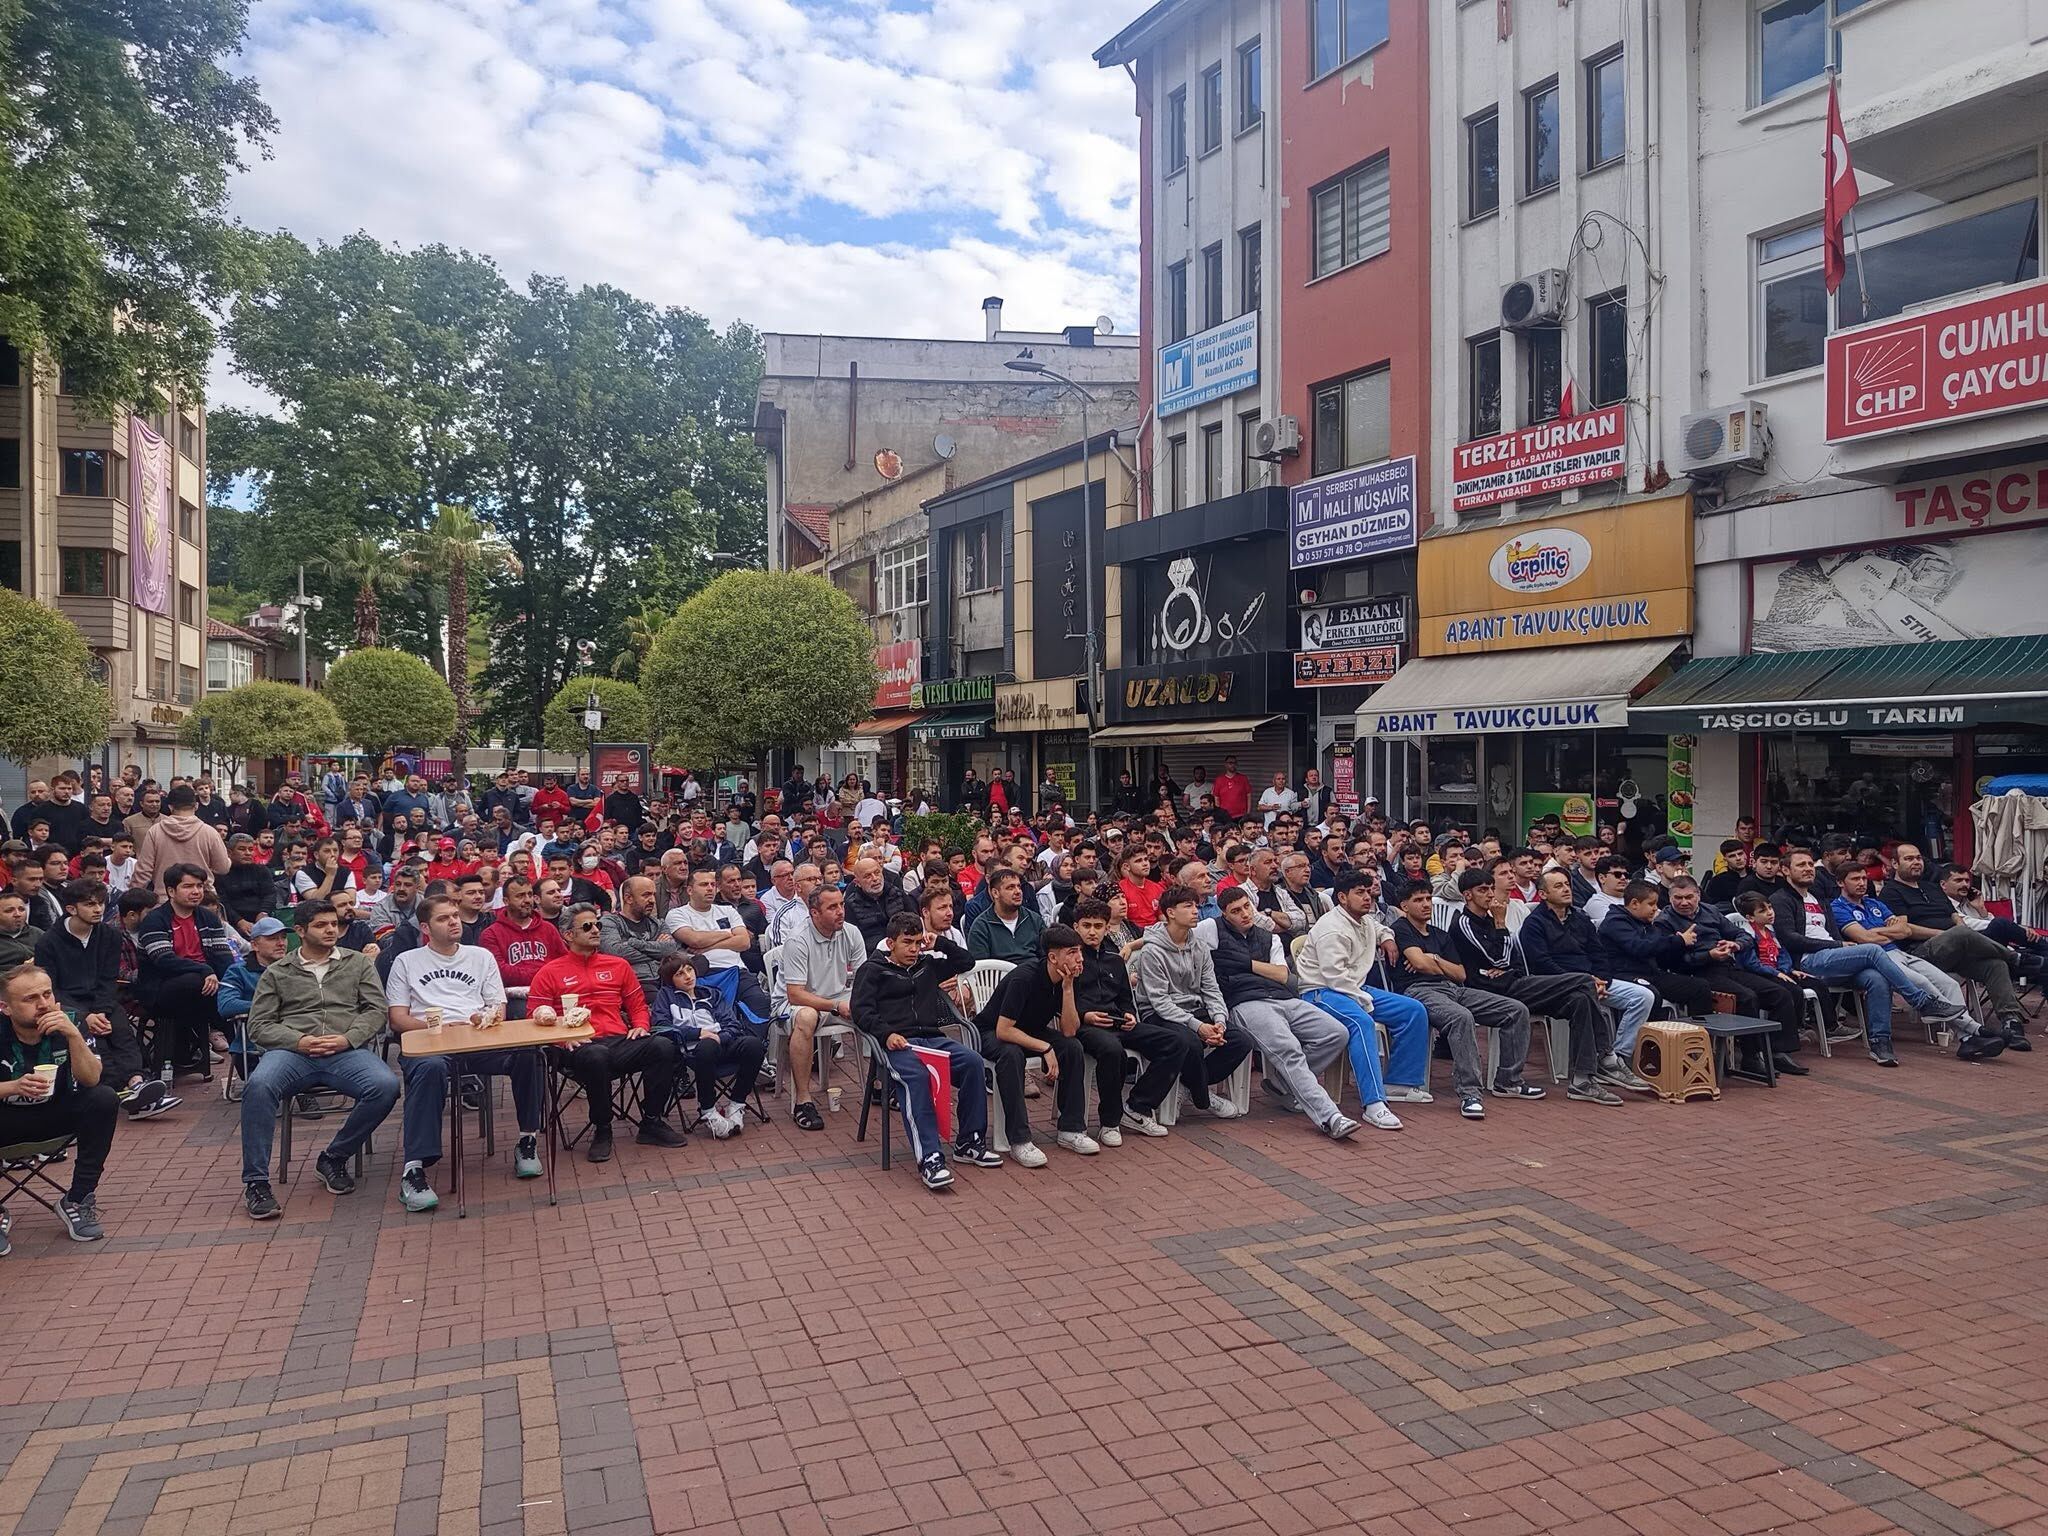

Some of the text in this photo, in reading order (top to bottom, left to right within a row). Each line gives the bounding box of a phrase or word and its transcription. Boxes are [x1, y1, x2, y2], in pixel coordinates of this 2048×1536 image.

[1196, 334, 1218, 350] SERBEST
[1197, 335, 1252, 367] MALİ MÜŞAVİR
[1224, 356, 1244, 371] AKTAŞ
[1942, 354, 2048, 410] ÇAYCU
[1855, 385, 1917, 417] CHP
[1522, 413, 1615, 453] TÜRKAN
[1583, 449, 1620, 467] YAPILIR
[1325, 478, 1358, 496] SERBEST
[1541, 477, 1567, 490] 0.536
[1569, 472, 1586, 484] 863
[1588, 470, 1598, 480] 41
[1601, 467, 1613, 478] 66
[1323, 482, 1409, 520] MALİ MÜŞAVİR
[1299, 513, 1406, 547] SEYHAN DÜZMEN
[1305, 552, 1310, 561] 0
[1311, 549, 1322, 560] 537
[1323, 547, 1334, 558] 571
[1335, 545, 1344, 555] 48
[1345, 544, 1353, 554] 78
[1511, 551, 1566, 578] erpiliç
[1863, 564, 1883, 580] STIHL
[1340, 603, 1391, 622] BARAN
[1446, 600, 1650, 643] ABANT TAVUKÇULUK
[1326, 619, 1403, 639] ERKEK KUAFÖRÜ
[1900, 614, 1942, 642] STIH
[1317, 650, 1394, 673] TERZİ
[952, 675, 993, 704] ÇİFTLİĞİ
[941, 723, 980, 738] ÇİFTLİĞİ
[1376, 704, 1600, 733] ABANT TAVUKÇULUK
[1698, 706, 1964, 731] TAŞCIOĞLU TARIM
[508, 940, 548, 966] GAP
[418, 969, 476, 987] ABERCROMBIE
